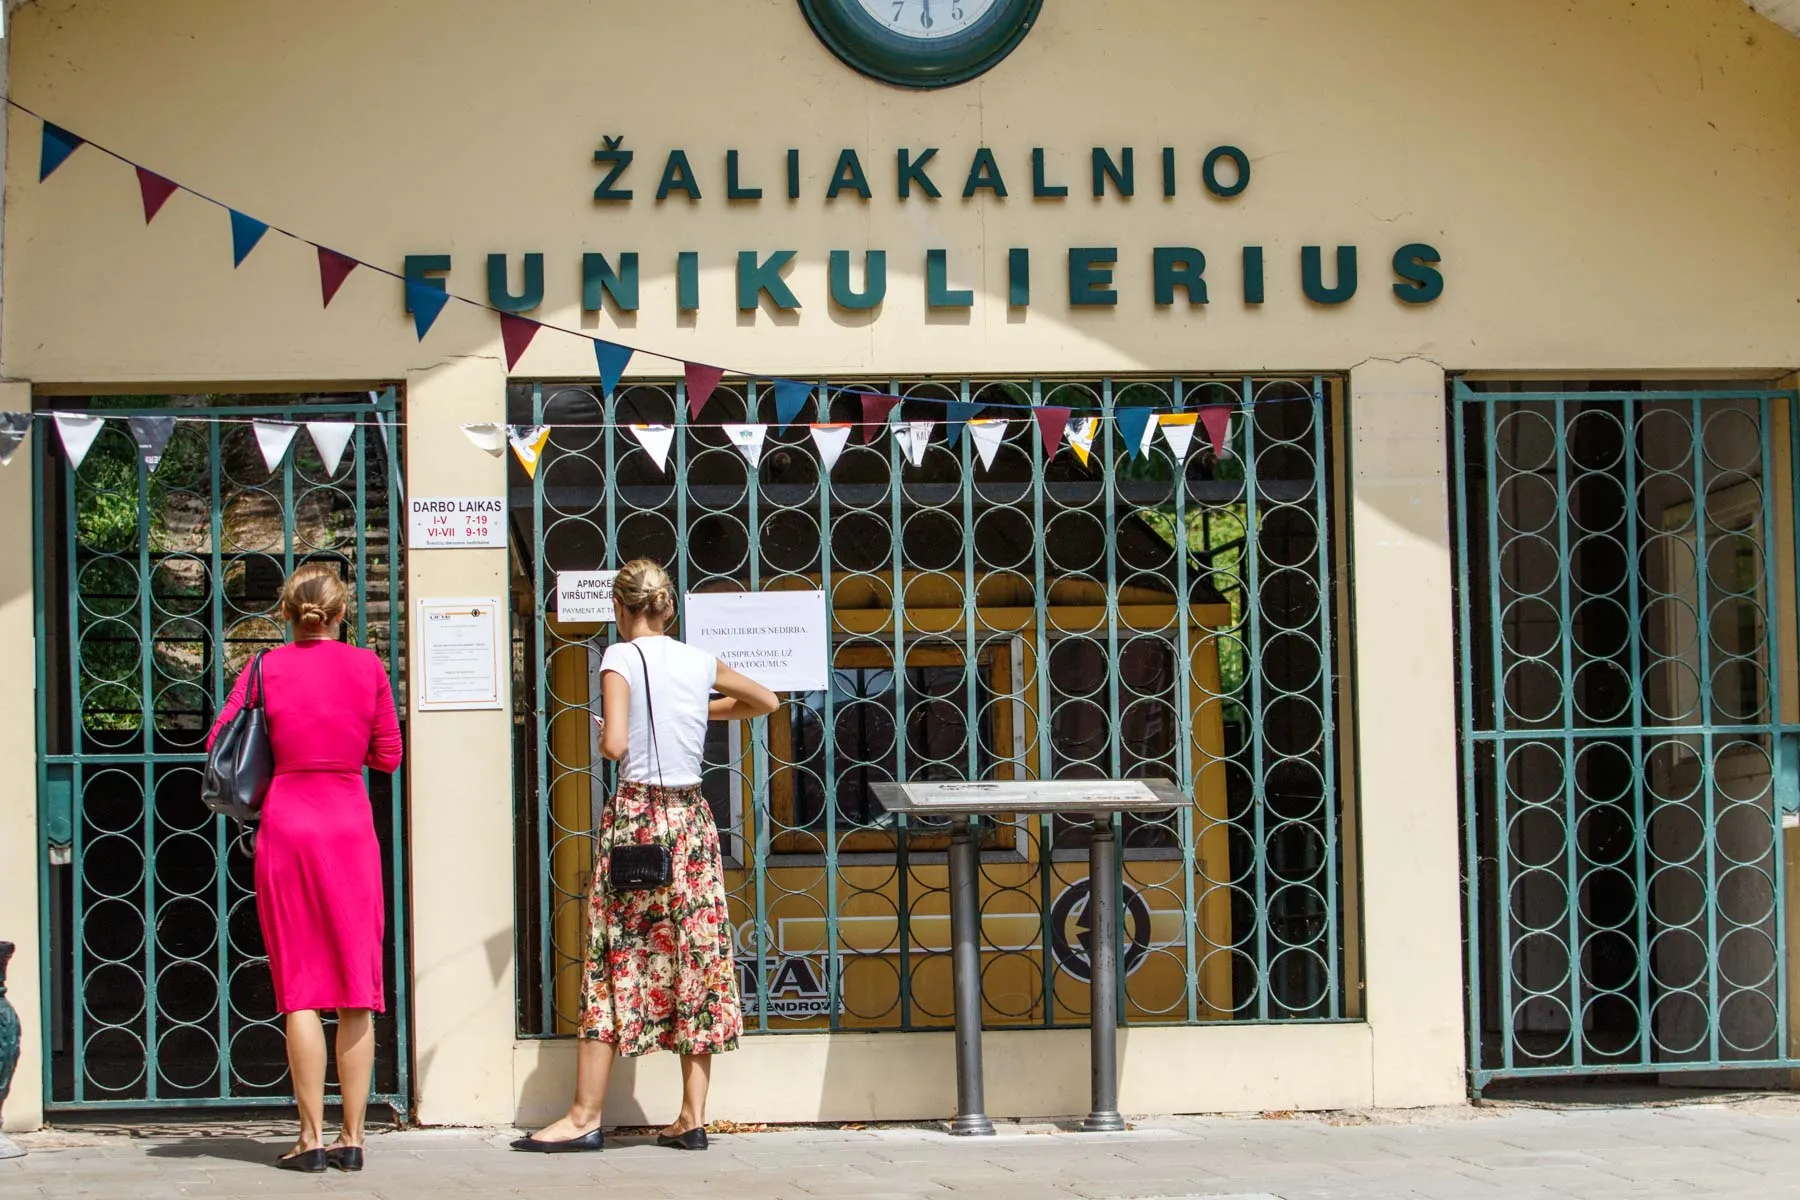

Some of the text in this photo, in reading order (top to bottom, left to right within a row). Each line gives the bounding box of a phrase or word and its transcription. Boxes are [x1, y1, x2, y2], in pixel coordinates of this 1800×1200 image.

[892, 1, 905, 22] 7
[951, 0, 964, 20] 5
[594, 135, 1252, 200] ŽALIAKALNIO
[404, 242, 1446, 313] FUNIKULIERIUS
[413, 500, 502, 513] DARBO LAIKAS
[433, 515, 488, 525] I-V 7-19
[427, 527, 488, 537] VI-VII 9-19
[720, 648, 793, 658] ATSIPRAŠOME UŽ
[727, 660, 789, 669] EPATOGUMUS.
